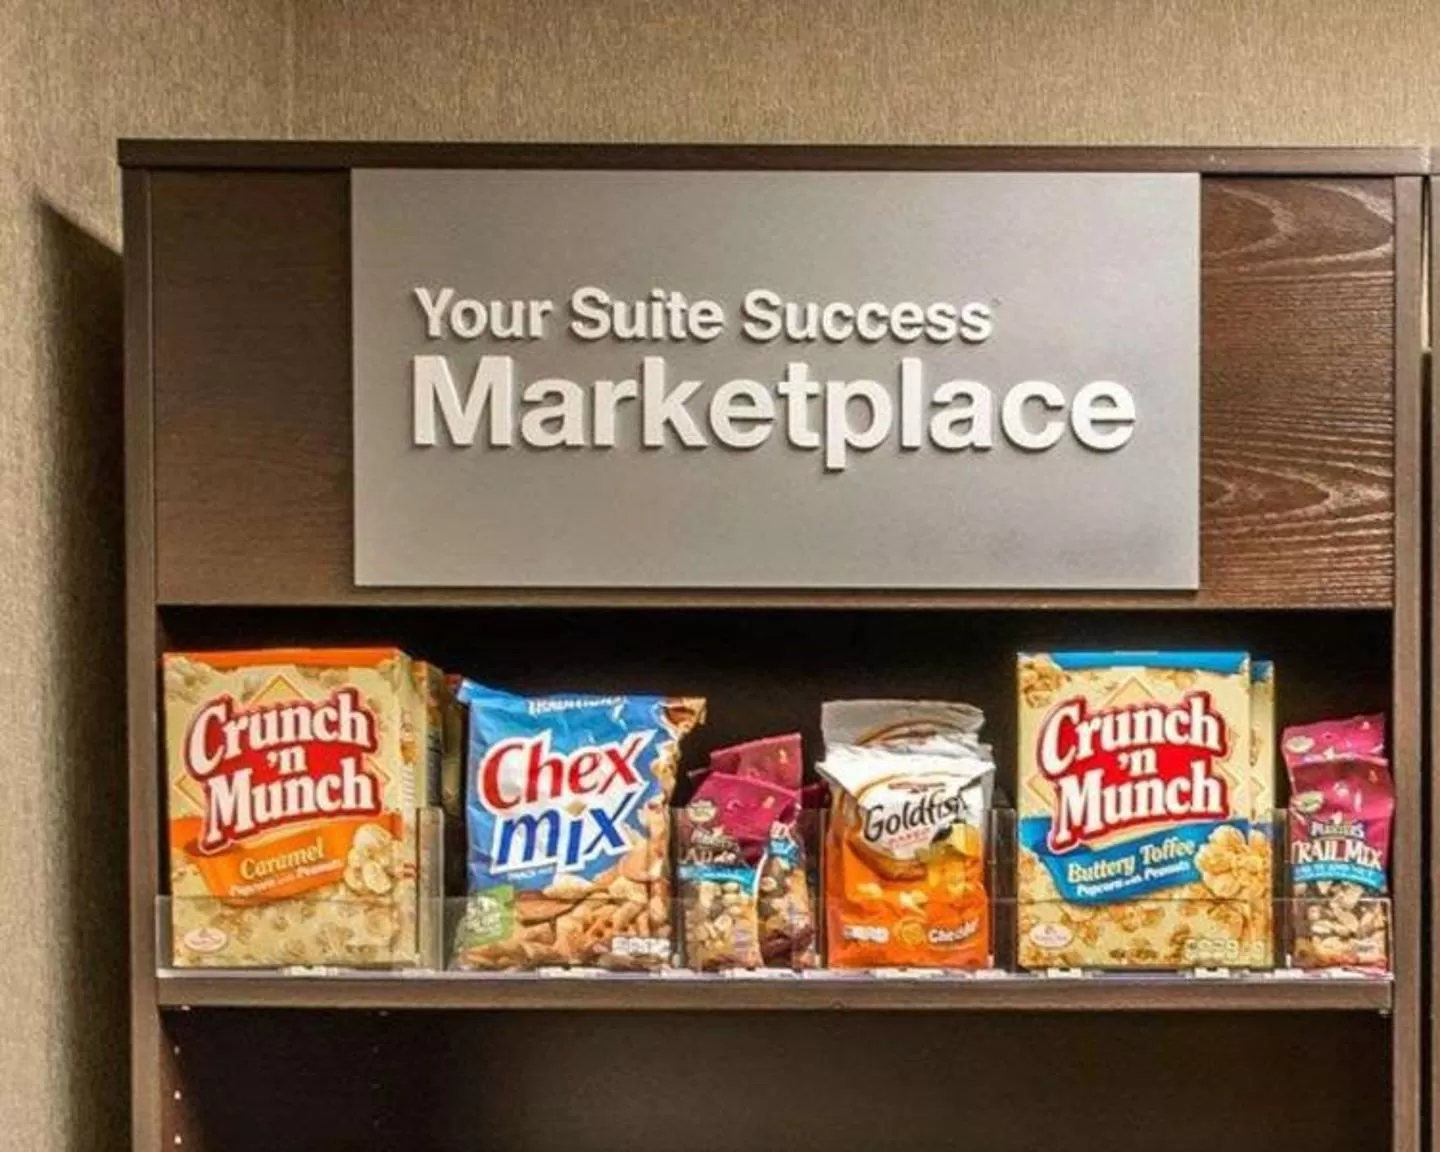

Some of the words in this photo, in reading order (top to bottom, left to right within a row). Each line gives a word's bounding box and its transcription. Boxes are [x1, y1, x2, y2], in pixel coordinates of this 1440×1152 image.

[413, 287, 553, 339] Your
[571, 287, 724, 341] Suite
[742, 289, 993, 343] Success
[413, 354, 1137, 470] Marketplace
[186, 690, 374, 774] Crunch
[1042, 692, 1222, 776] Crunch
[205, 768, 378, 844] Munch
[481, 733, 644, 812] Chex
[1056, 760, 1222, 844] Munch
[863, 787, 970, 842] Goldfish
[238, 841, 325, 882] Caramel
[1066, 854, 1136, 885] Buttery
[1141, 836, 1197, 864] Toffee
[1343, 840, 1384, 871] MIX
